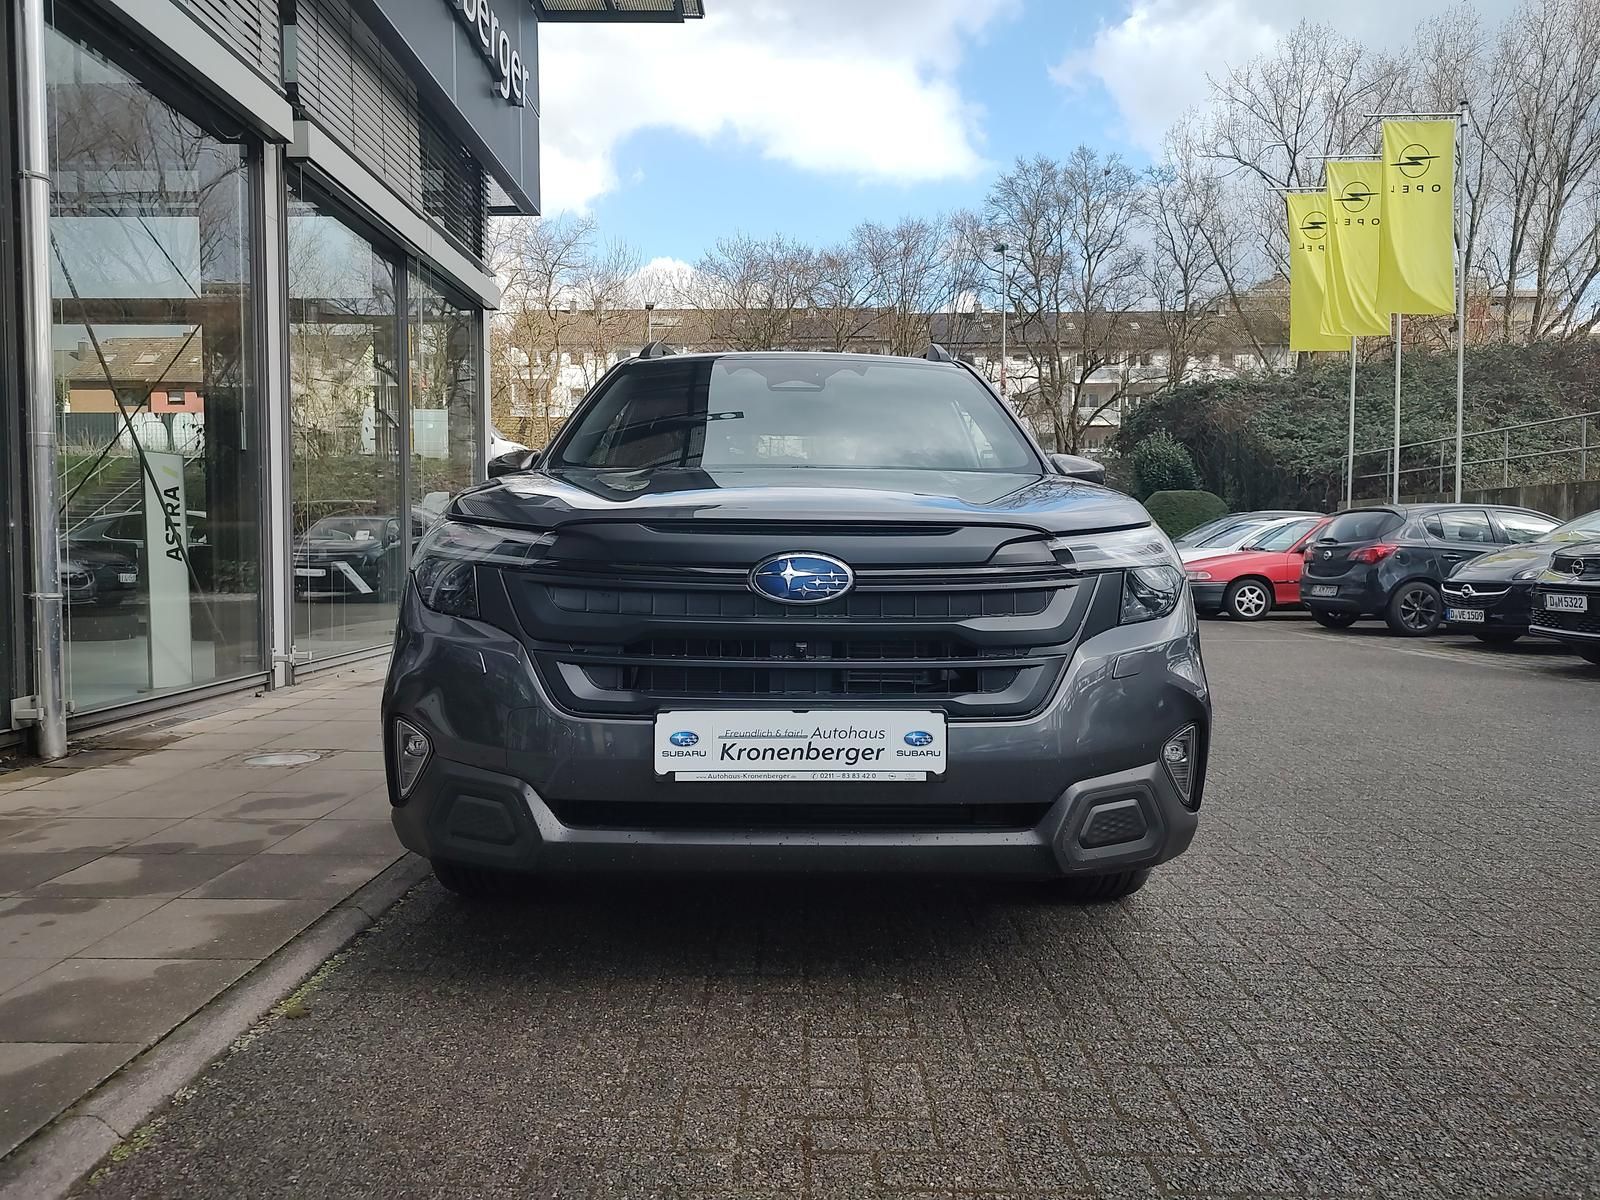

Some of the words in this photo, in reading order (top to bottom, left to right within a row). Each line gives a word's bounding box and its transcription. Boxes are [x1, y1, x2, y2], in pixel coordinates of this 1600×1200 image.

[164, 486, 182, 562] ASTRA
[725, 729, 773, 738] Freundlich
[775, 729, 782, 738] &
[784, 729, 804, 738] fair!
[811, 725, 886, 739] Autohaus
[661, 750, 707, 758] SUBARU
[720, 741, 885, 765] Kronenberger
[896, 749, 941, 758] SUBARU
